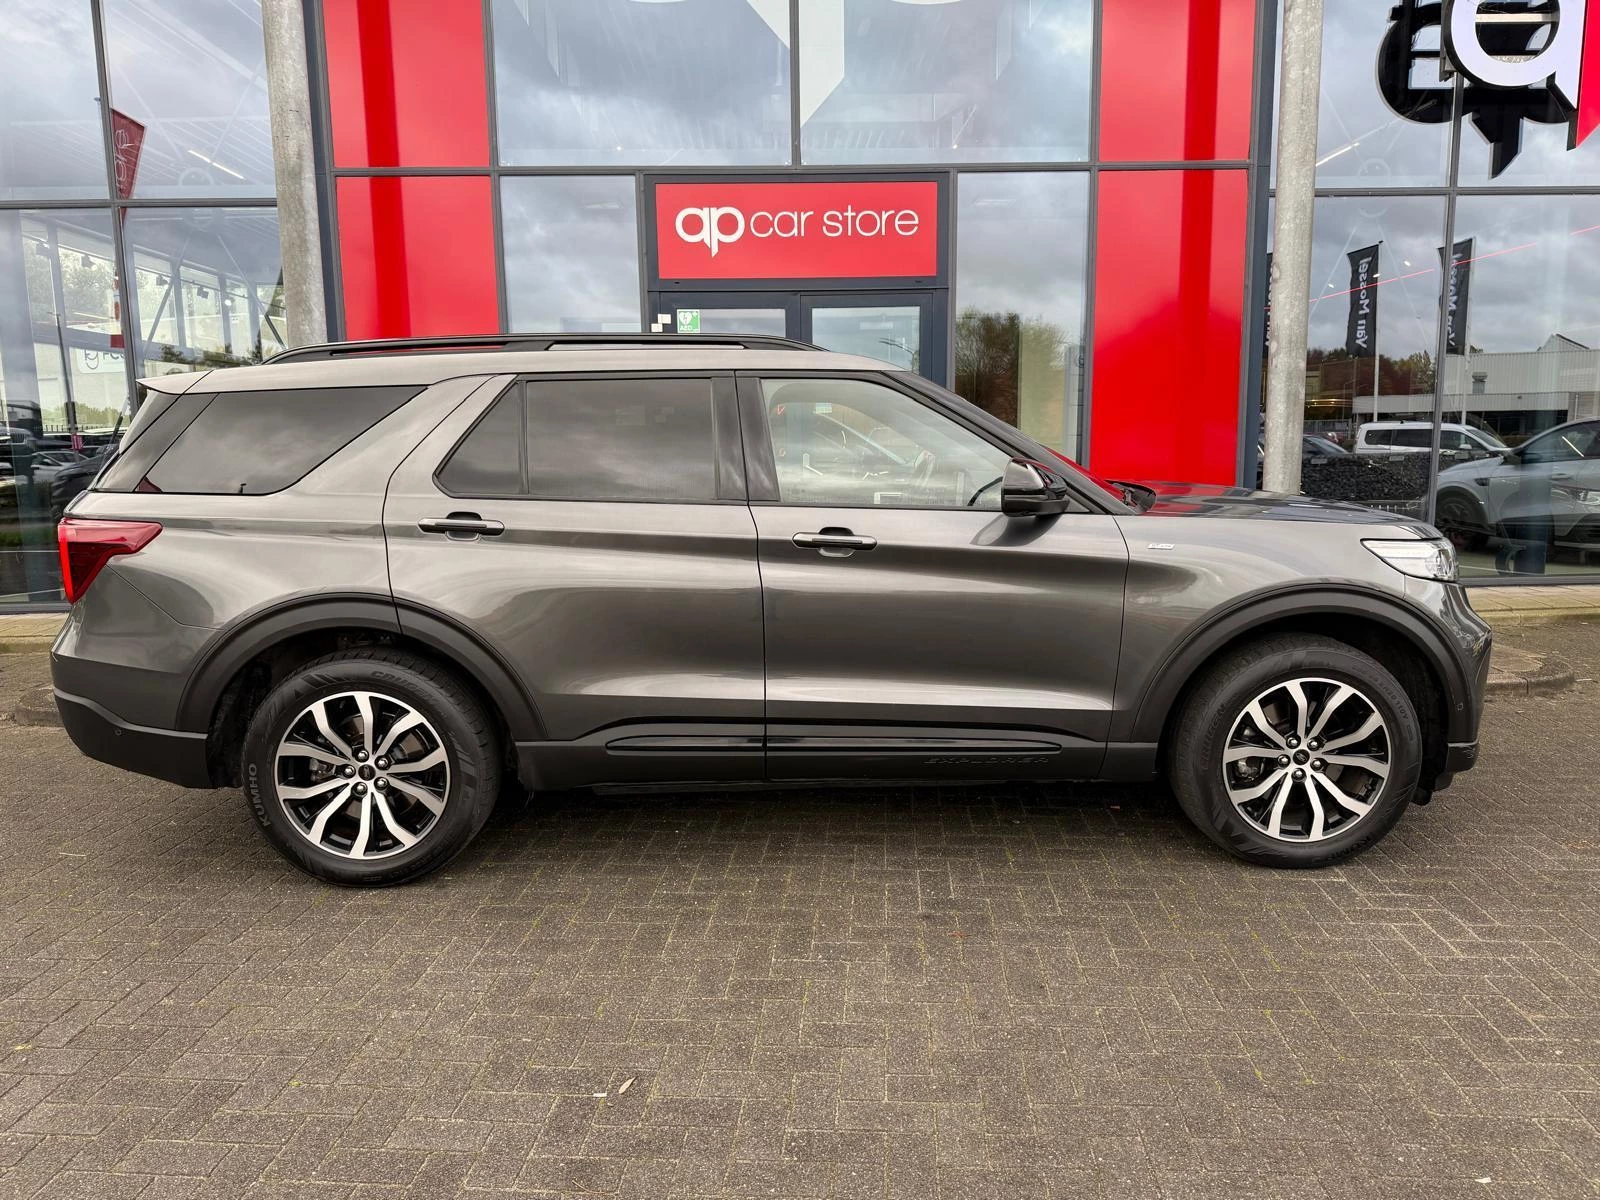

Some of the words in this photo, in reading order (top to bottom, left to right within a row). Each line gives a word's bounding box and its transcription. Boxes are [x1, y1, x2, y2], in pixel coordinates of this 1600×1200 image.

[675, 207, 746, 258] ap
[750, 211, 814, 238] car
[822, 205, 919, 237] store
[248, 763, 272, 827] KUMHO
